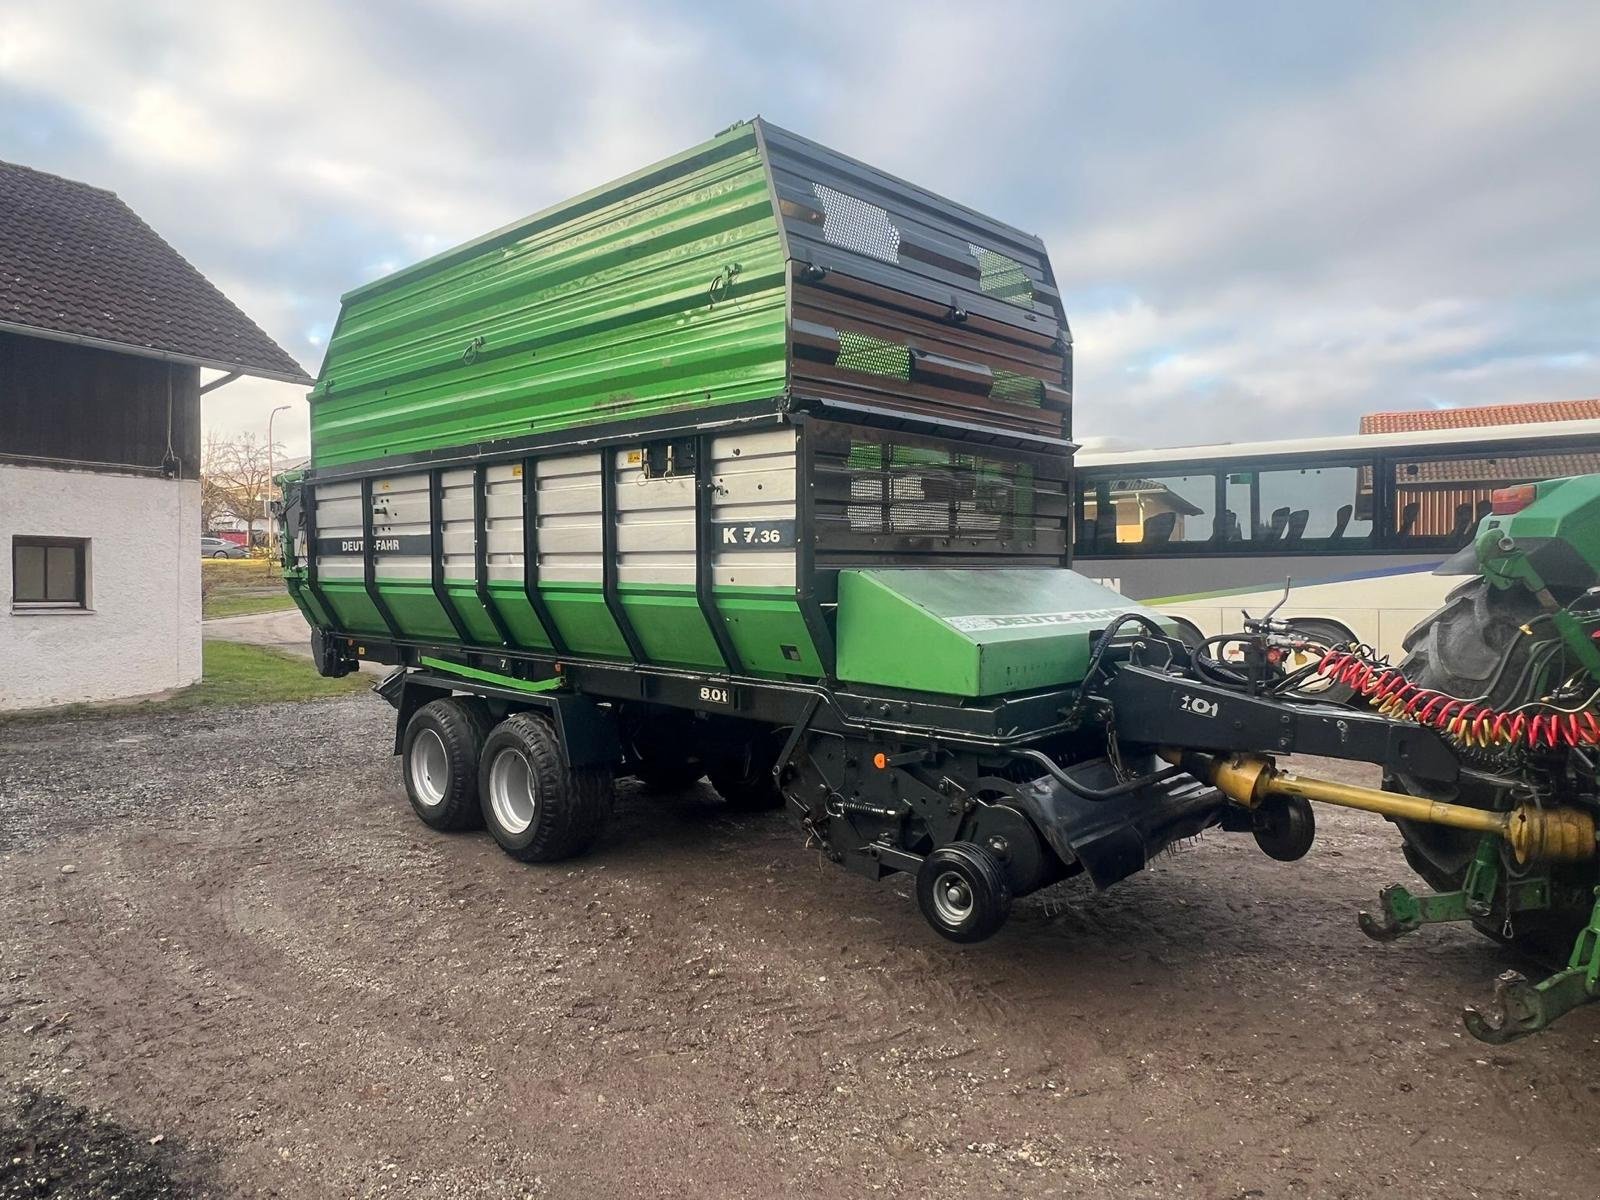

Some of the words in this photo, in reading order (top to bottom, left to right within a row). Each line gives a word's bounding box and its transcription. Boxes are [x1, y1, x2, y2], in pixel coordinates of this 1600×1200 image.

[723, 527, 738, 544] K
[743, 527, 780, 544] 7.36
[342, 539, 400, 552] DEUT-FAHR
